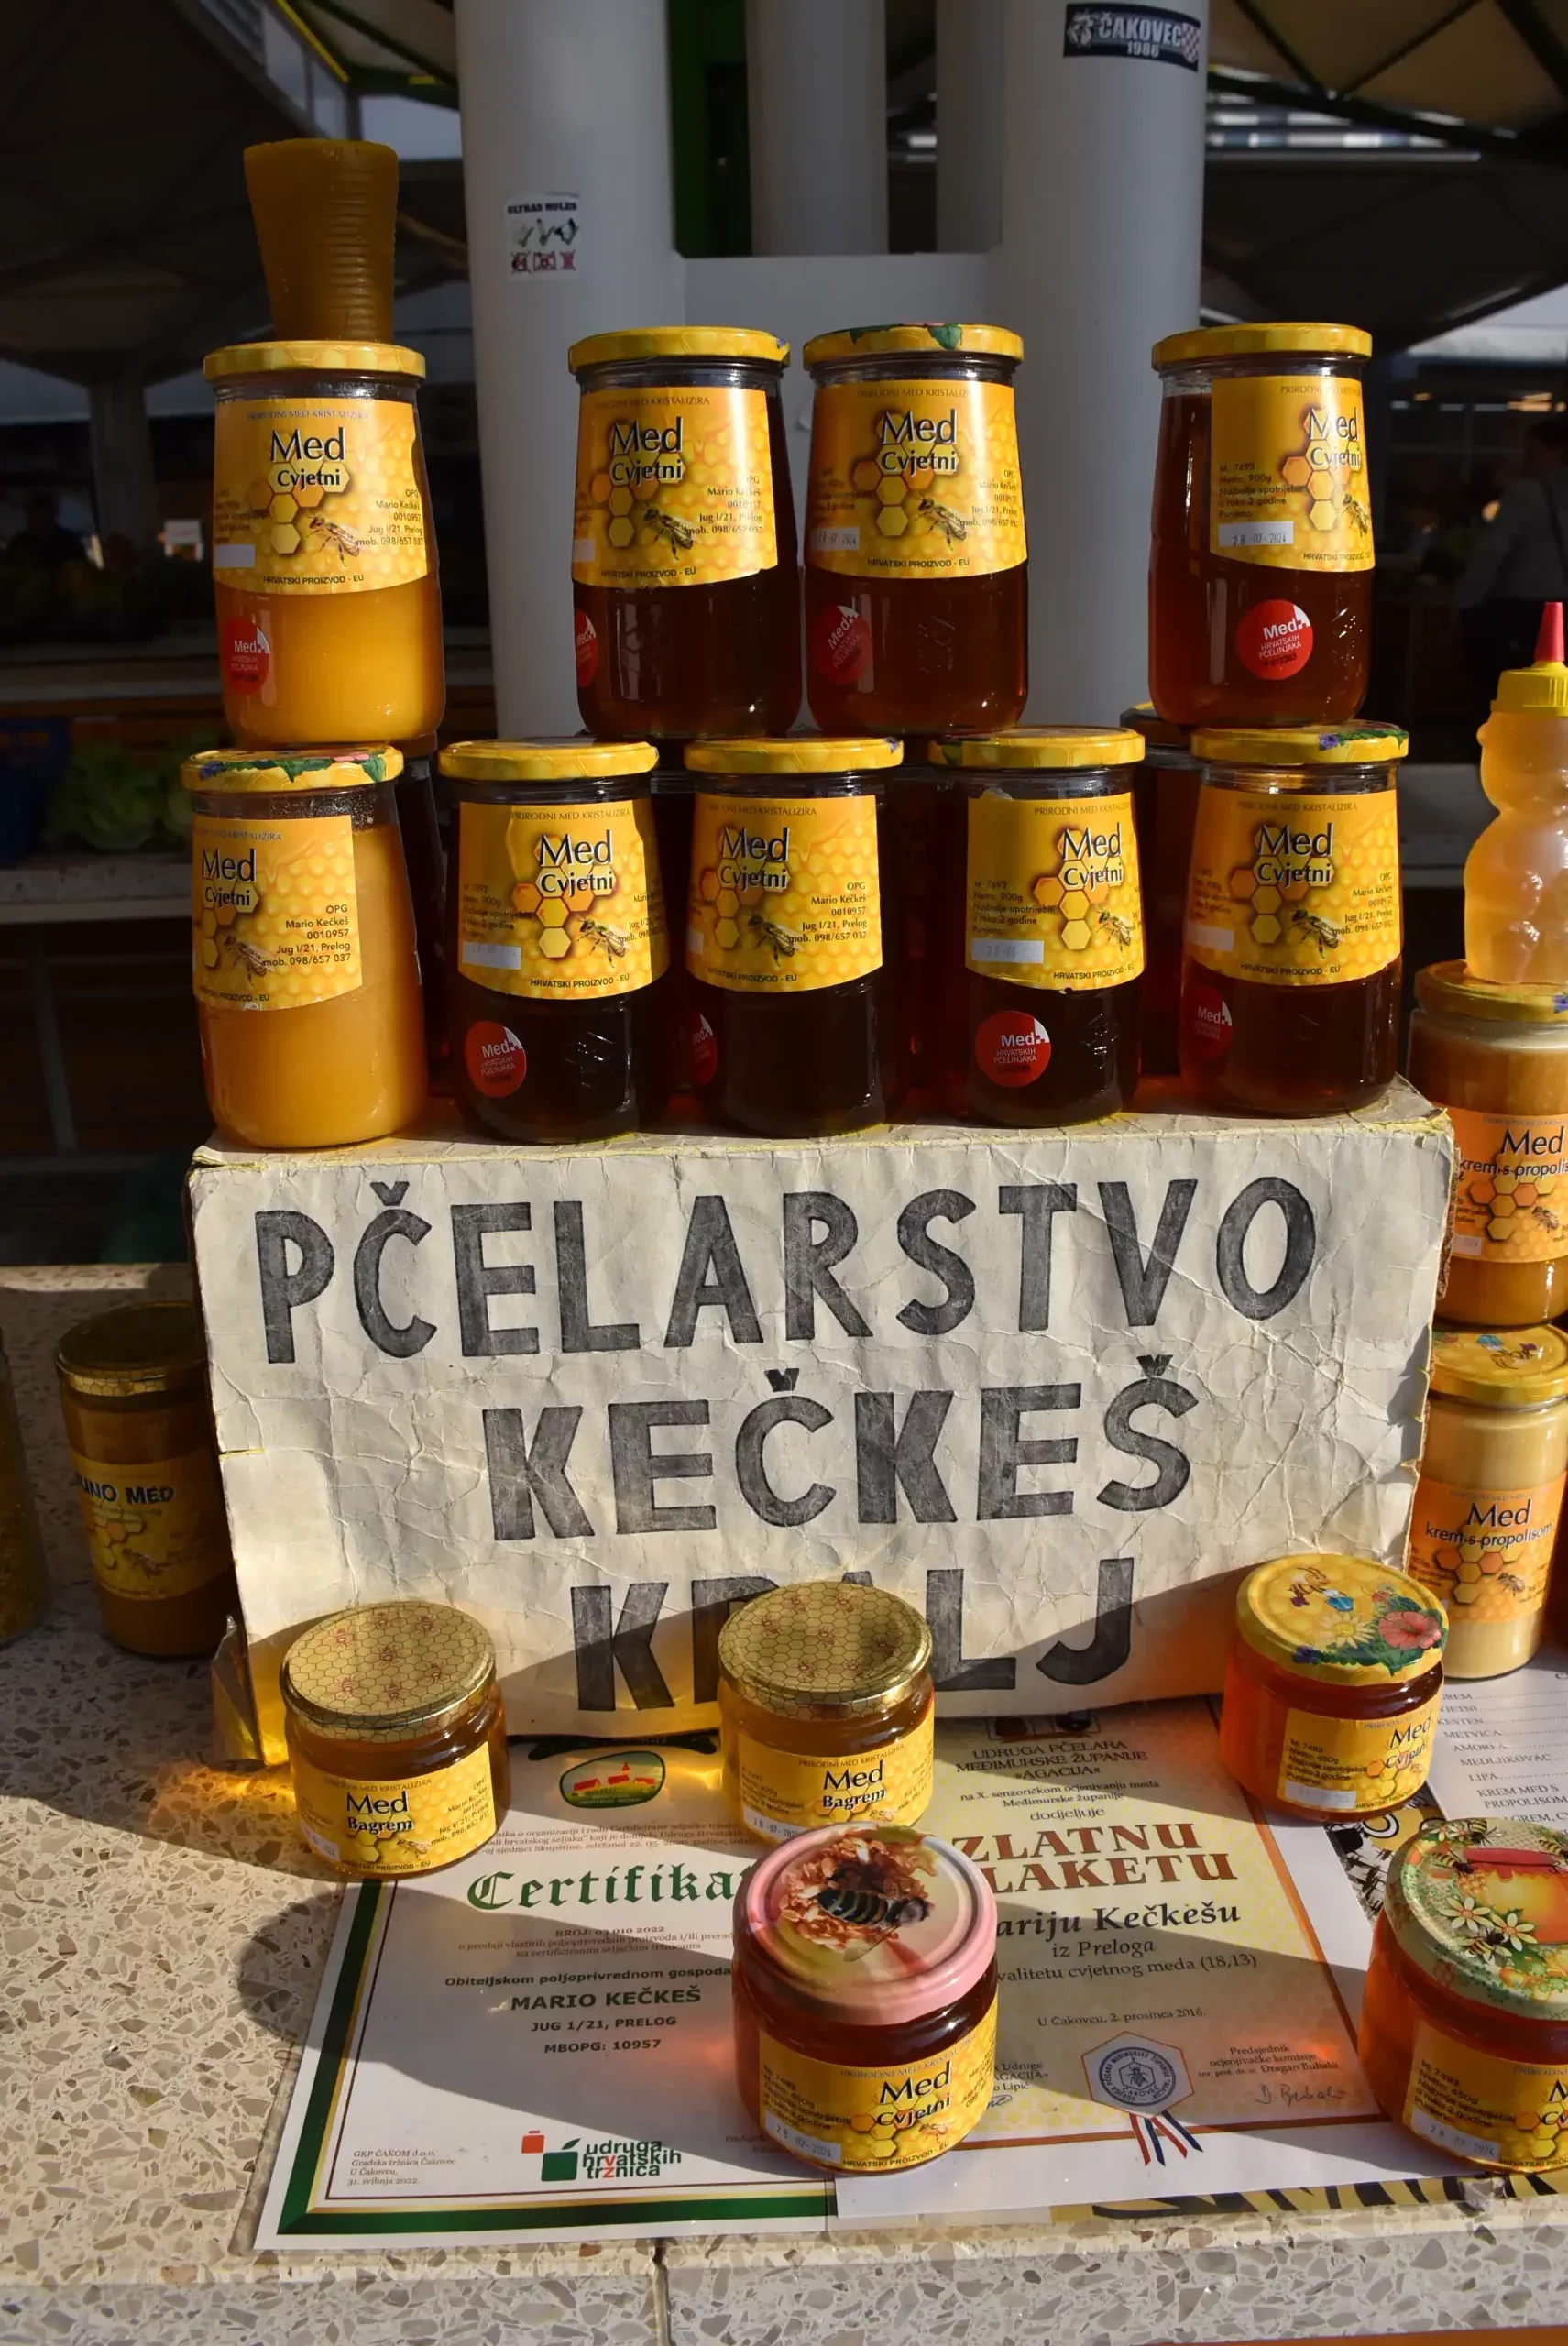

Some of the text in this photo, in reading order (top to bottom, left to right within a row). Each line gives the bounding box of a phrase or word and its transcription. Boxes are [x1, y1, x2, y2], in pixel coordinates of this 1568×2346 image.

[1100, 11, 1181, 47] ČAKOVEC
[1127, 40, 1159, 58] 1986
[881, 409, 957, 444] Med
[1308, 407, 1358, 441] Med
[270, 426, 345, 462] Med
[610, 417, 682, 454] Med
[882, 451, 957, 475] Cvjetni
[1310, 447, 1361, 470] Cvjetni
[277, 468, 341, 491] Cvjetni
[612, 459, 683, 485] Cvjetni
[685, 567, 696, 576] EU
[867, 558, 970, 567] HRVATSKI PROIZVOD EU
[263, 575, 364, 585] HRVATSKI PROIZVOD EU
[1263, 618, 1297, 640] Med
[1261, 634, 1299, 651] HRVATSKIH
[512, 808, 630, 821] PRIRODNI MED KRISTALIZIRA
[759, 806, 817, 816] KRISTALIZIRA
[1035, 806, 1098, 816] PRIRODNI MED
[540, 829, 612, 868] Med
[720, 827, 789, 862] Med
[1063, 822, 1122, 861] Med
[1257, 823, 1334, 857] Med
[202, 848, 257, 882] Med
[721, 866, 787, 891] Cvjetni
[1064, 863, 1123, 891] Cvjetni
[1257, 862, 1332, 887] Cvjetni
[541, 872, 613, 897] Cvjetni
[847, 882, 866, 891] OPG
[205, 887, 251, 909] Cvjetni
[811, 894, 866, 904] Mario Kečkeš
[326, 904, 347, 914] OPG
[831, 907, 866, 915] 0010957
[286, 917, 349, 928] Mario Kečkeš
[802, 919, 867, 931] Jug Prelog
[1008, 917, 1037, 926] godine
[307, 929, 349, 939] 0010957
[815, 933, 850, 941] 098/657
[853, 931, 866, 939] 037
[277, 942, 350, 955] Jug Prelog
[290, 955, 330, 965] 098/657
[334, 953, 350, 962] 037
[738, 973, 797, 982] PROIZVOD EU
[1053, 967, 1124, 980] HRVATSKI PROIZVOD
[1280, 964, 1341, 975] PROIZVOD EU
[531, 974, 630, 988] HRVATSKI PROIZVOD EU
[481, 1039, 510, 1058] Med
[1001, 1032, 1035, 1047] Med
[996, 1048, 1036, 1057] HRVATSKIH
[1500, 1125, 1565, 1156] Med
[1461, 1160, 1498, 1173] krem
[255, 1177, 1316, 1364] PČELARSTVO
[482, 1354, 1199, 1541] KEČKEŠ
[126, 1486, 174, 1504] MED
[1466, 1498, 1531, 1528] Med
[1426, 1522, 1552, 1550] krem propolisom
[1389, 1709, 1432, 1749] Med
[973, 1740, 1128, 1760] UDRUGA PČELARA
[957, 1751, 1148, 1772] MEĐIMURSKE ŽUPANIJE
[824, 1760, 883, 1790] Med
[823, 1787, 885, 1810] Bagrem
[992, 1787, 1062, 1799] senzoričkom
[1477, 1785, 1547, 1797] KREM MED
[346, 1791, 409, 1814] Med
[1484, 1796, 1568, 1808] PROPOLISOM
[1030, 1807, 1105, 1821] dodjeljuje
[347, 1817, 414, 1835] Bagrem
[952, 1823, 1202, 1862] ZLATNU
[981, 1853, 1238, 1894] LAKETU
[996, 1901, 1241, 1942] ariju Kečkešu
[555, 1928, 592, 1937] BROJ:
[1052, 1939, 1155, 1959] iz Preloga
[1068, 1962, 1144, 1979] cvjetnog
[1147, 1958, 1195, 1973] meda
[1201, 1953, 1257, 1972] (18,13)
[445, 1968, 663, 1988] Obiteljskom poljoprivrednom
[511, 1986, 702, 2011] MARIO KEČKEŠ
[531, 2017, 676, 2033] JUG 1/21, PRELOG
[1124, 2010, 1173, 2023] prosinca
[544, 2040, 662, 2054] MBOPG: 10957
[1230, 2045, 1290, 2055] Predsjednik
[1261, 2064, 1299, 2074] Dragan
[880, 2061, 952, 2104] Med
[877, 2093, 951, 2126] Cvjetni
[375, 2149, 410, 2157] ČAKOM
[587, 2140, 662, 2154] udruga
[843, 2140, 949, 2167] HRVATSKI PROIZVOD EU
[583, 2149, 682, 2167] hrvatskih
[362, 2177, 393, 2186] svibnja
